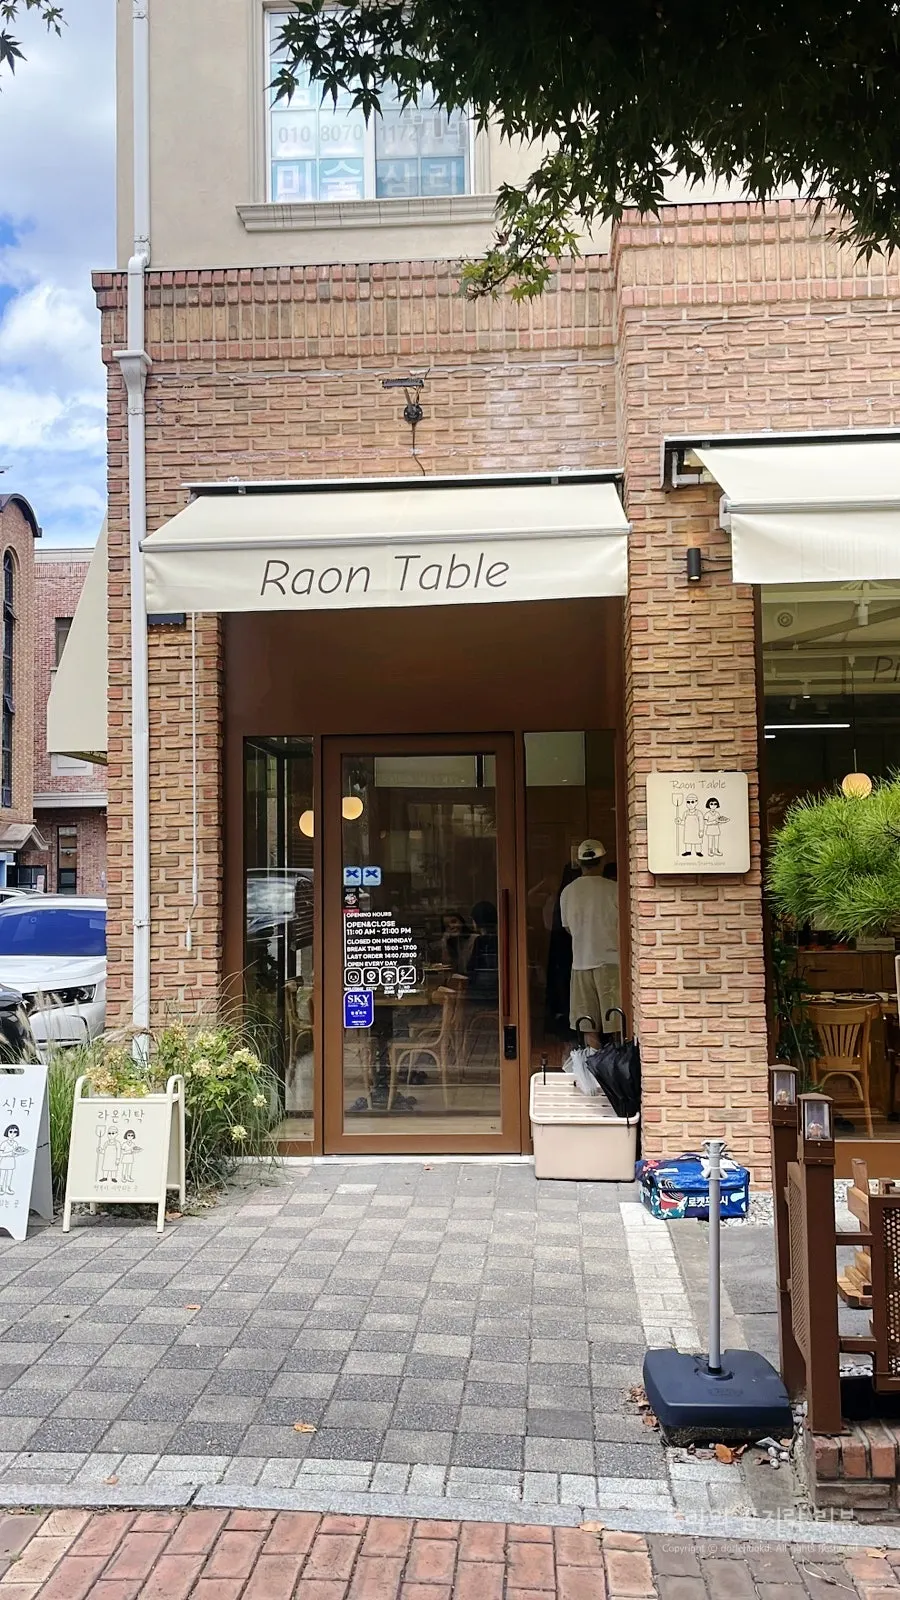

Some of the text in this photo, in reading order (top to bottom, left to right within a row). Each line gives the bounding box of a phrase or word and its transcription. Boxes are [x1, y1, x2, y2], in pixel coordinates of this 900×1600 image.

[278, 126, 311, 144] 010
[321, 124, 363, 142] 8070
[277, 160, 457, 201] 미술 심리
[260, 552, 510, 596] Raon Table
[669, 780, 726, 789] Raon Table
[346, 920, 396, 928] OPEN&CLOSE
[348, 994, 370, 1003] SKY
[2, 1097, 34, 1116] 식탁
[98, 1109, 146, 1124] 라온식탁
[688, 1195, 728, 1208] 로켓시
